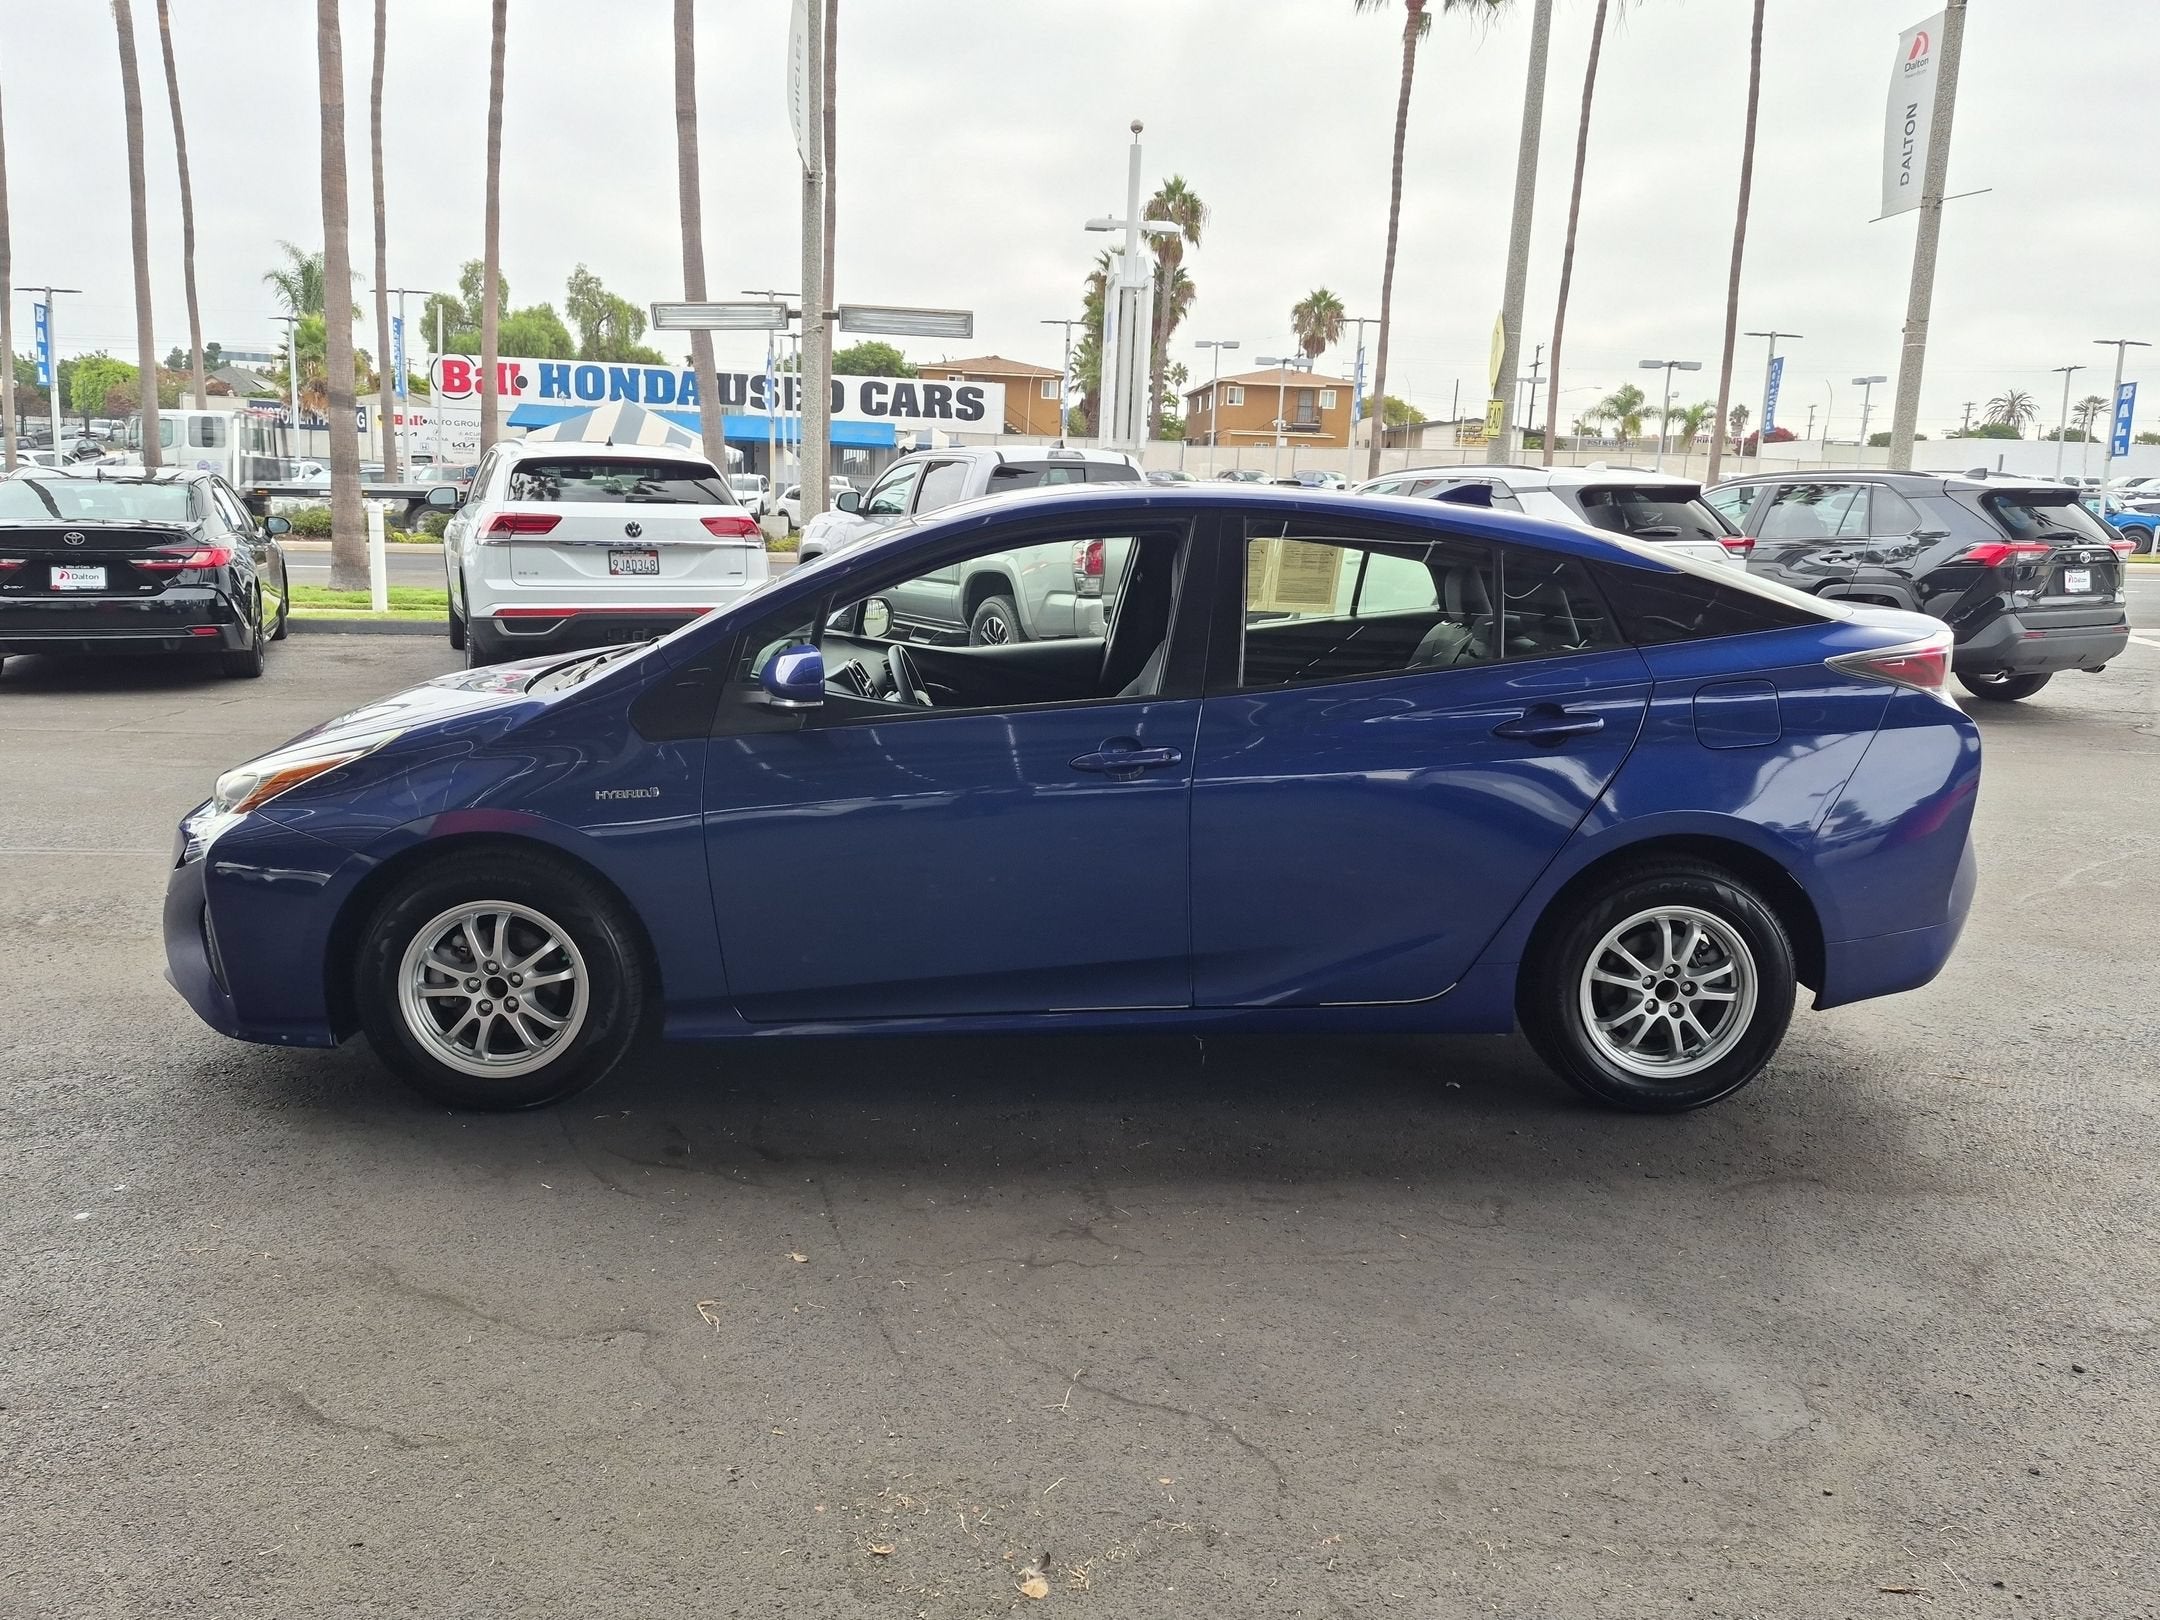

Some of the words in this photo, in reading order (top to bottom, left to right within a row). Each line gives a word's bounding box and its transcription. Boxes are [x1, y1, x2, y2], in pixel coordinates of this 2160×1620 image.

[1904, 57, 1929, 72] Dalton
[1900, 102, 1918, 186] DALTON
[36, 306, 48, 383] BALL
[539, 363, 700, 405] HONDA
[860, 381, 985, 421] CARS
[2114, 385, 2134, 455] BALL
[612, 559, 656, 572] 9JAD348
[595, 788, 648, 800] HYBRID
